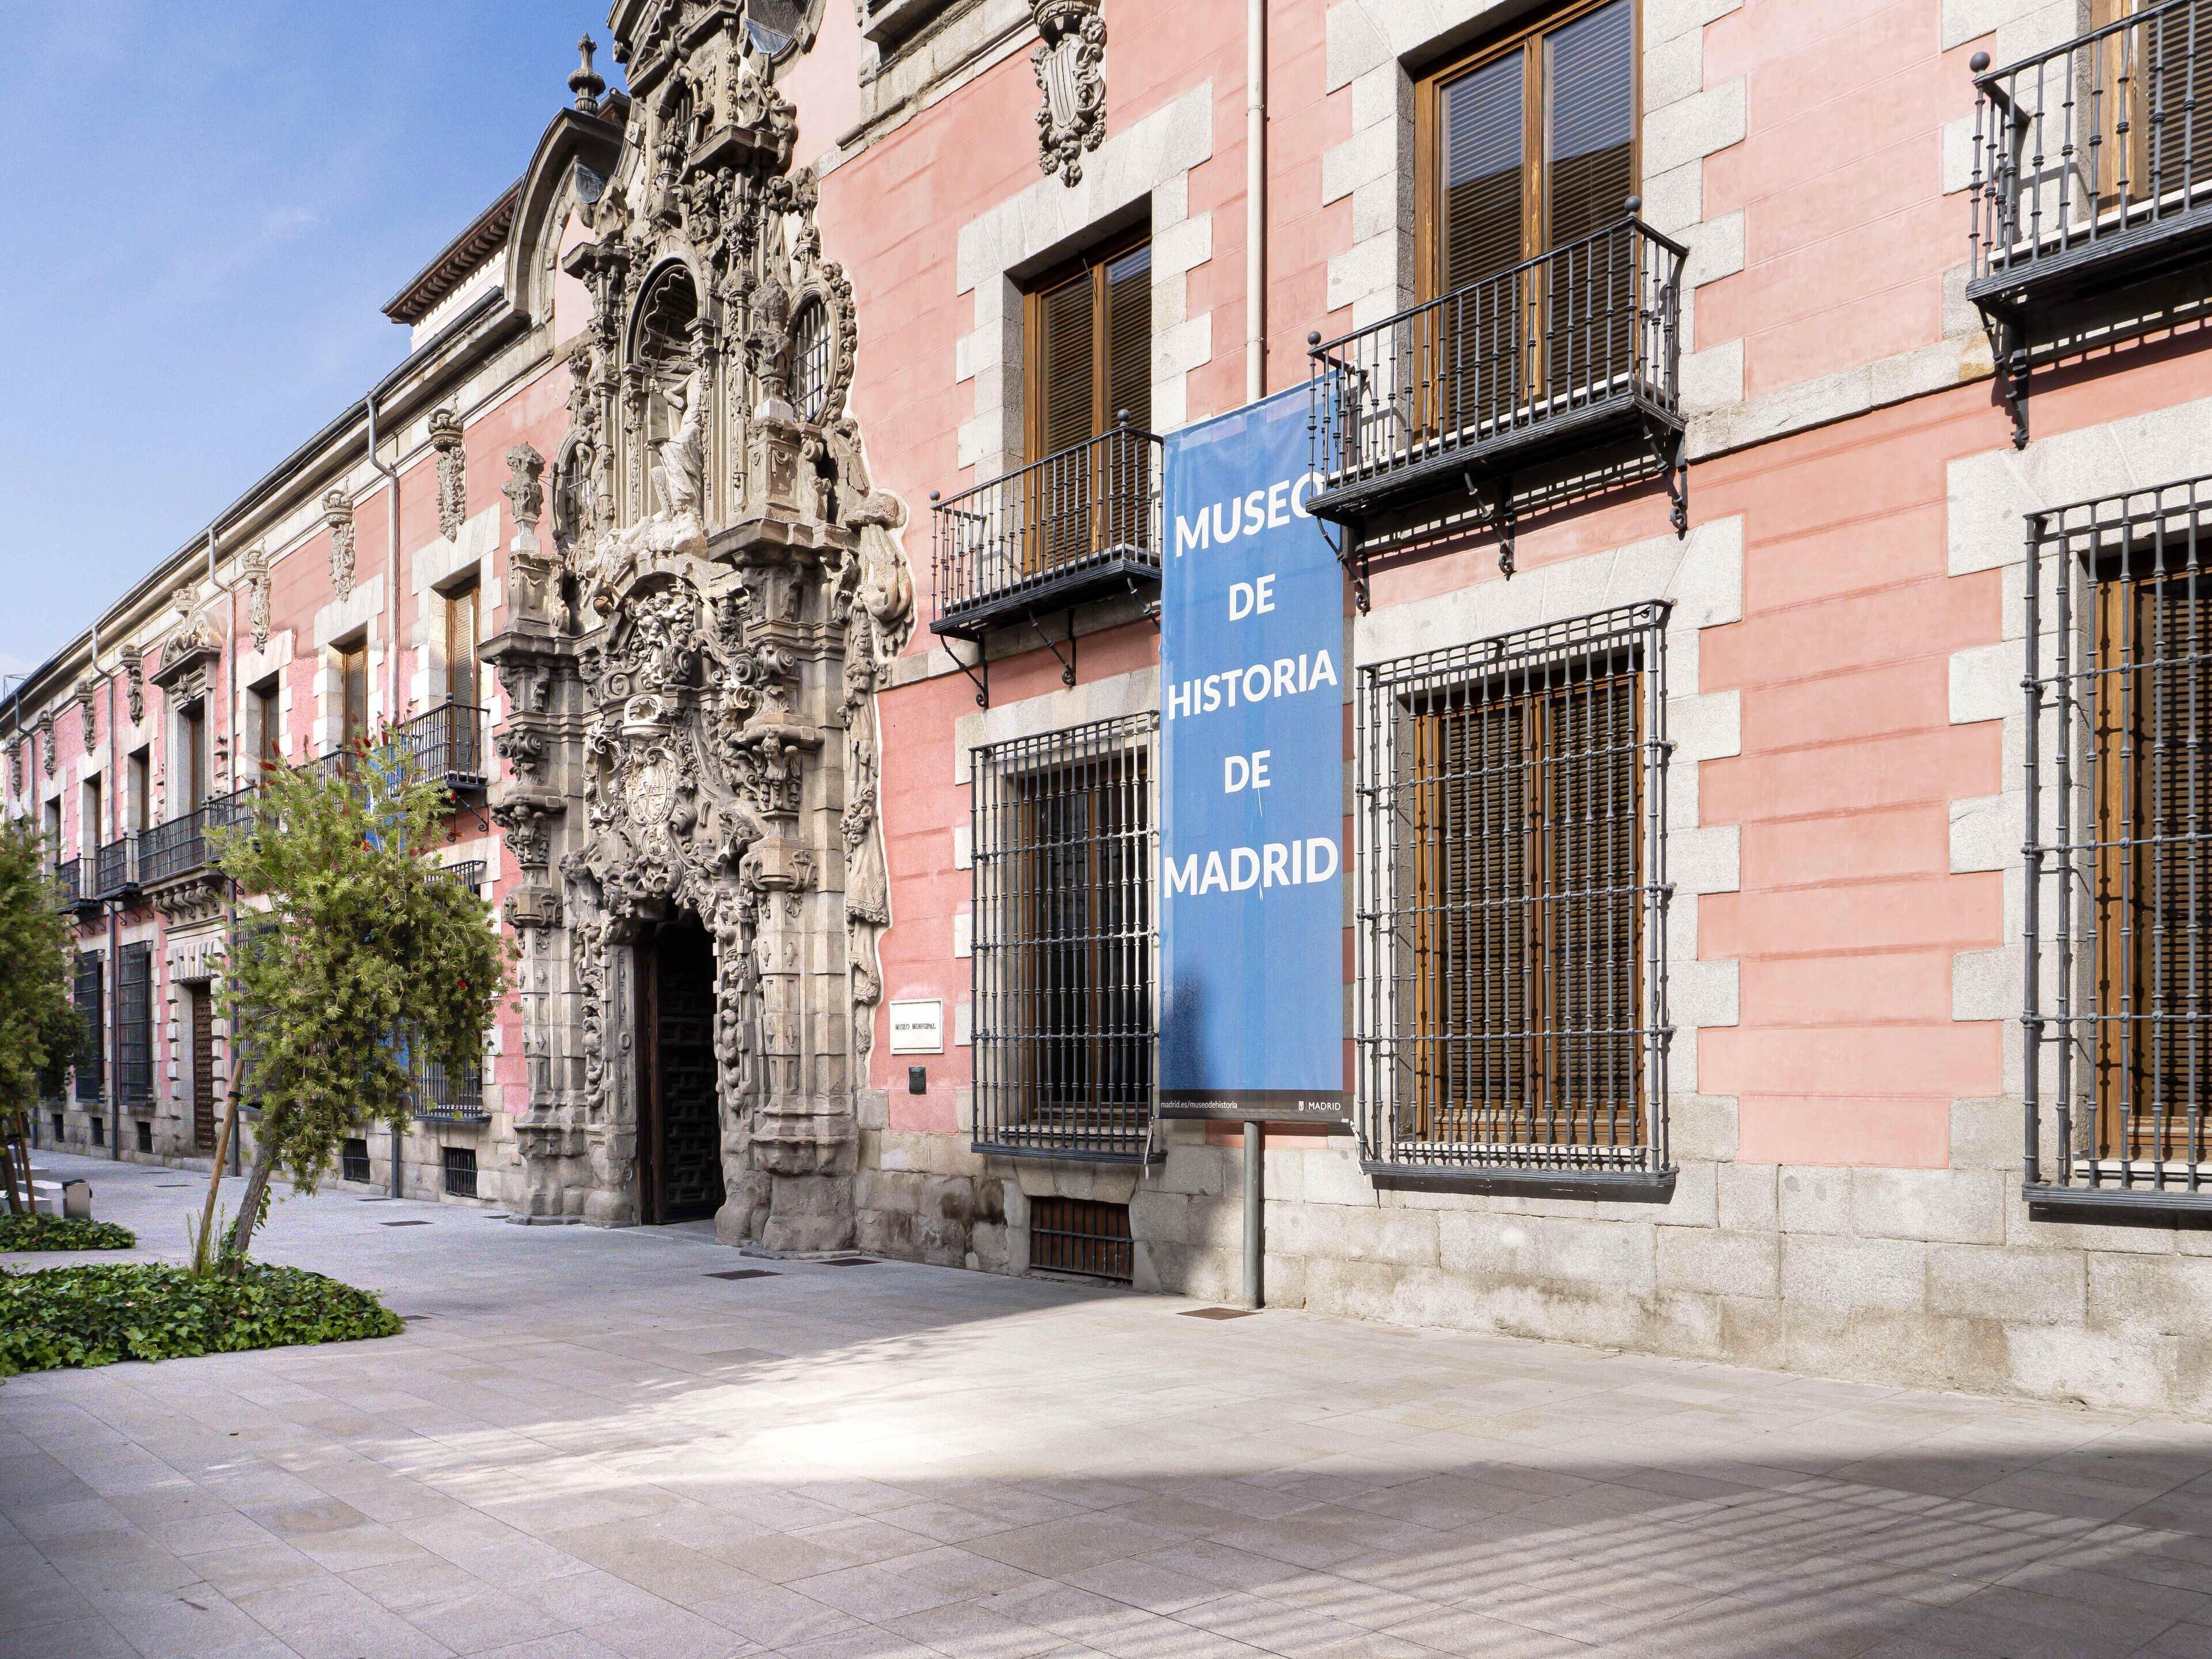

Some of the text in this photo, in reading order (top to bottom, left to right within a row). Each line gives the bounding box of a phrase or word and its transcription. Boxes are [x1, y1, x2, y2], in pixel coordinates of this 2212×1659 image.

[1176, 471, 1325, 558] MUSEO
[1229, 573, 1275, 621] DE
[1168, 649, 1338, 720] HISTORIA
[1225, 749, 1271, 793] DE
[1164, 837, 1338, 899] MADRID
[1161, 1101, 1238, 1109] madrid.es/museodehistoria
[1308, 1101, 1341, 1111] MADRID
